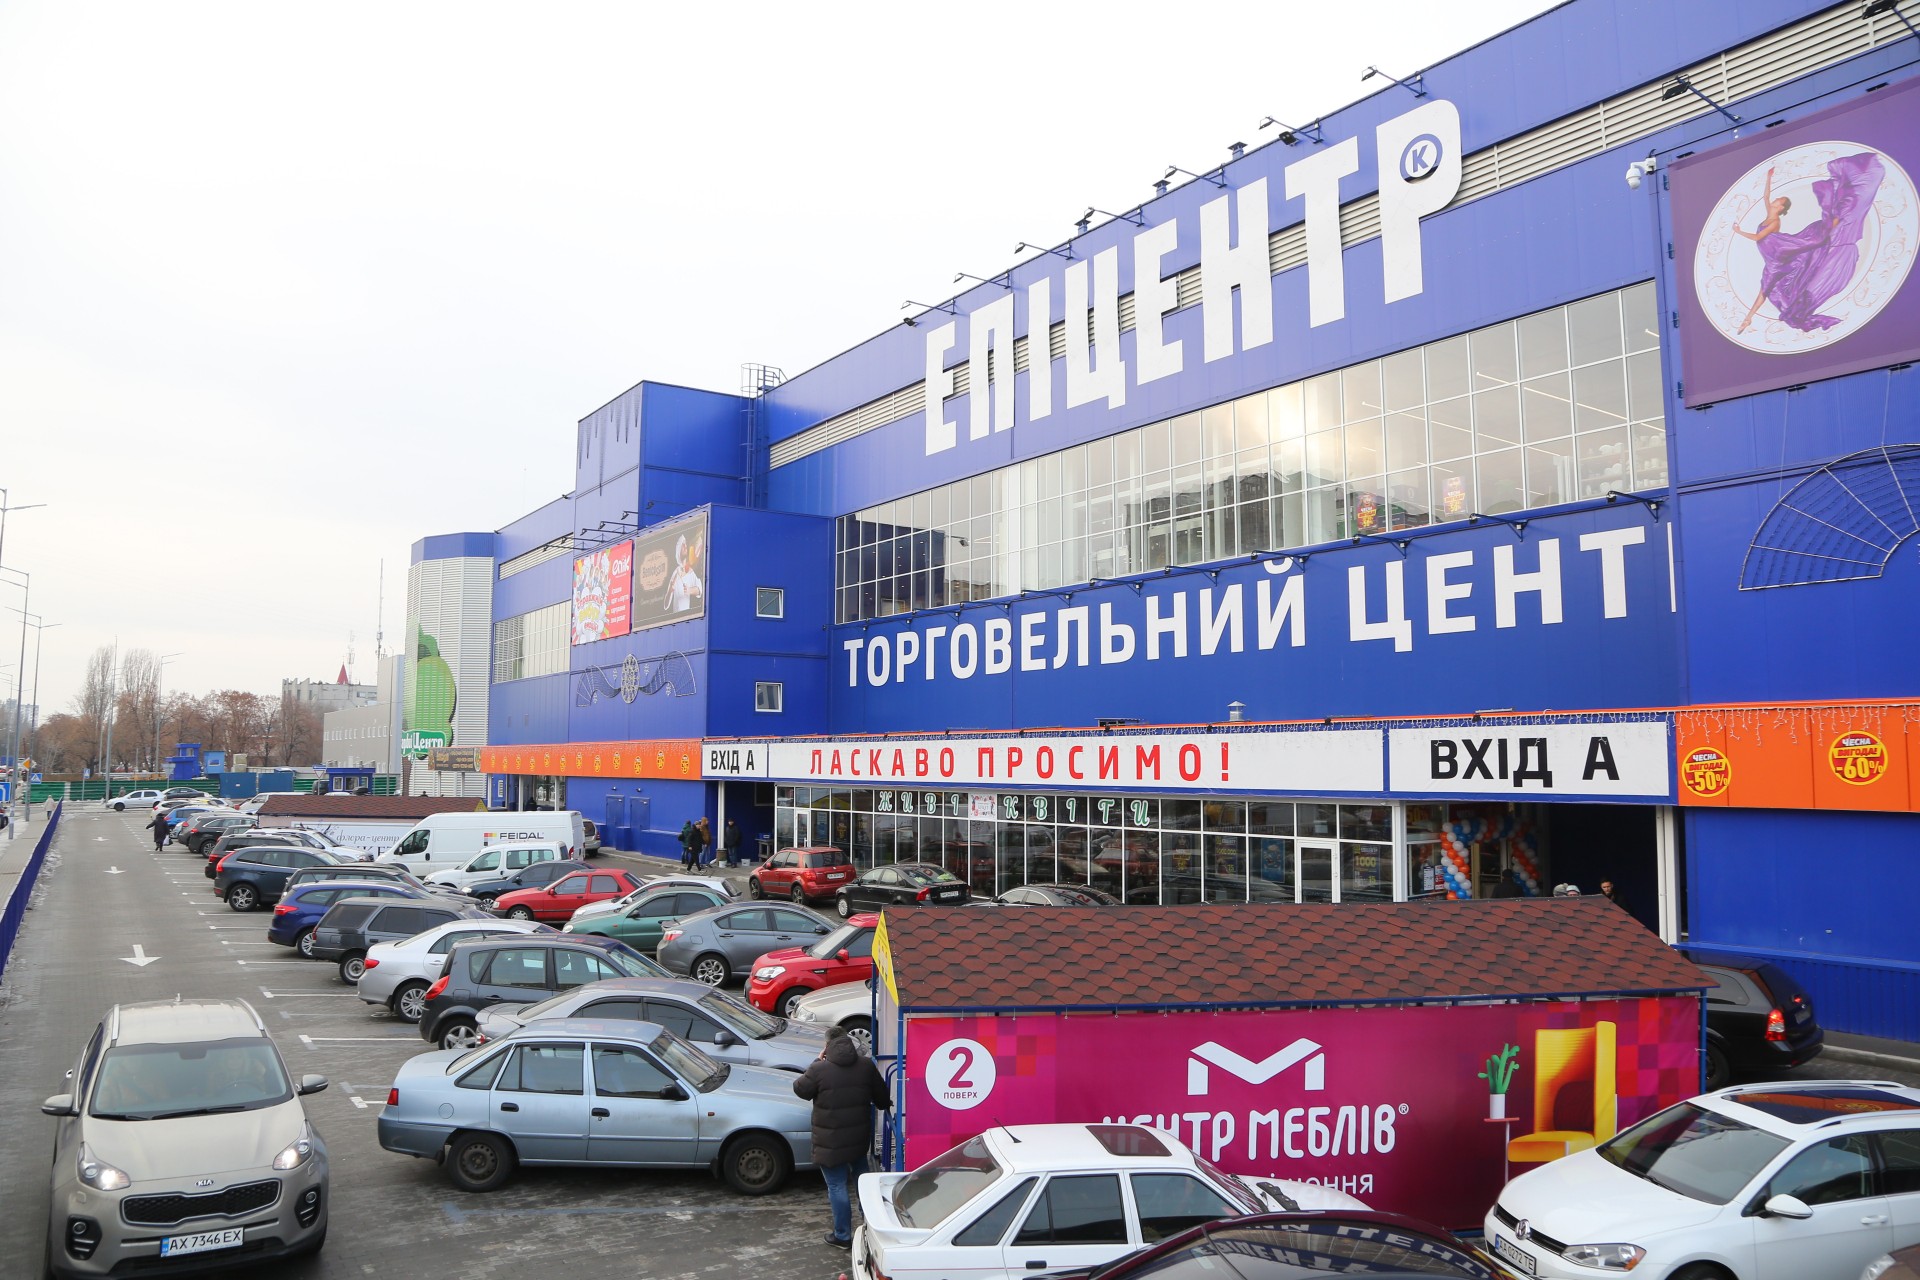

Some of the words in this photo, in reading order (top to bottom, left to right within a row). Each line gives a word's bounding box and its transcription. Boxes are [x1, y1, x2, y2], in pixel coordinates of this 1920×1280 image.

[924, 98, 1463, 457] ЕПІЦЕНТР
[843, 558, 1307, 689] ТОРГОВЕЛЬНИЙ
[1347, 521, 1677, 653] ЦЕНТ
[1837, 746, 1878, 758] ВИГОДА!
[1842, 737, 1871, 747] ЧЕСНА
[711, 750, 740, 774] ВХІД
[746, 750, 755, 770] А
[810, 746, 955, 777] ЛАСКАВО
[977, 742, 1230, 782] ПРОСИМО!
[1430, 737, 1553, 788] ВХІД
[1582, 736, 1620, 780] А
[1688, 761, 1723, 772] ВИГОДА!
[1692, 753, 1717, 762] ЧЕСНА
[1836, 757, 1884, 779] -60%
[1688, 771, 1728, 791] -50%
[1003, 796, 1150, 827] КВІТИ
[500, 832, 544, 840] FEIDAL
[948, 1046, 974, 1088] 2
[943, 1091, 978, 1099] ПОВЕРХ
[169, 1238, 188, 1251] AX
[192, 1233, 221, 1248] 7346
[223, 1229, 242, 1242] EX
[1524, 1255, 1534, 1270] TE
